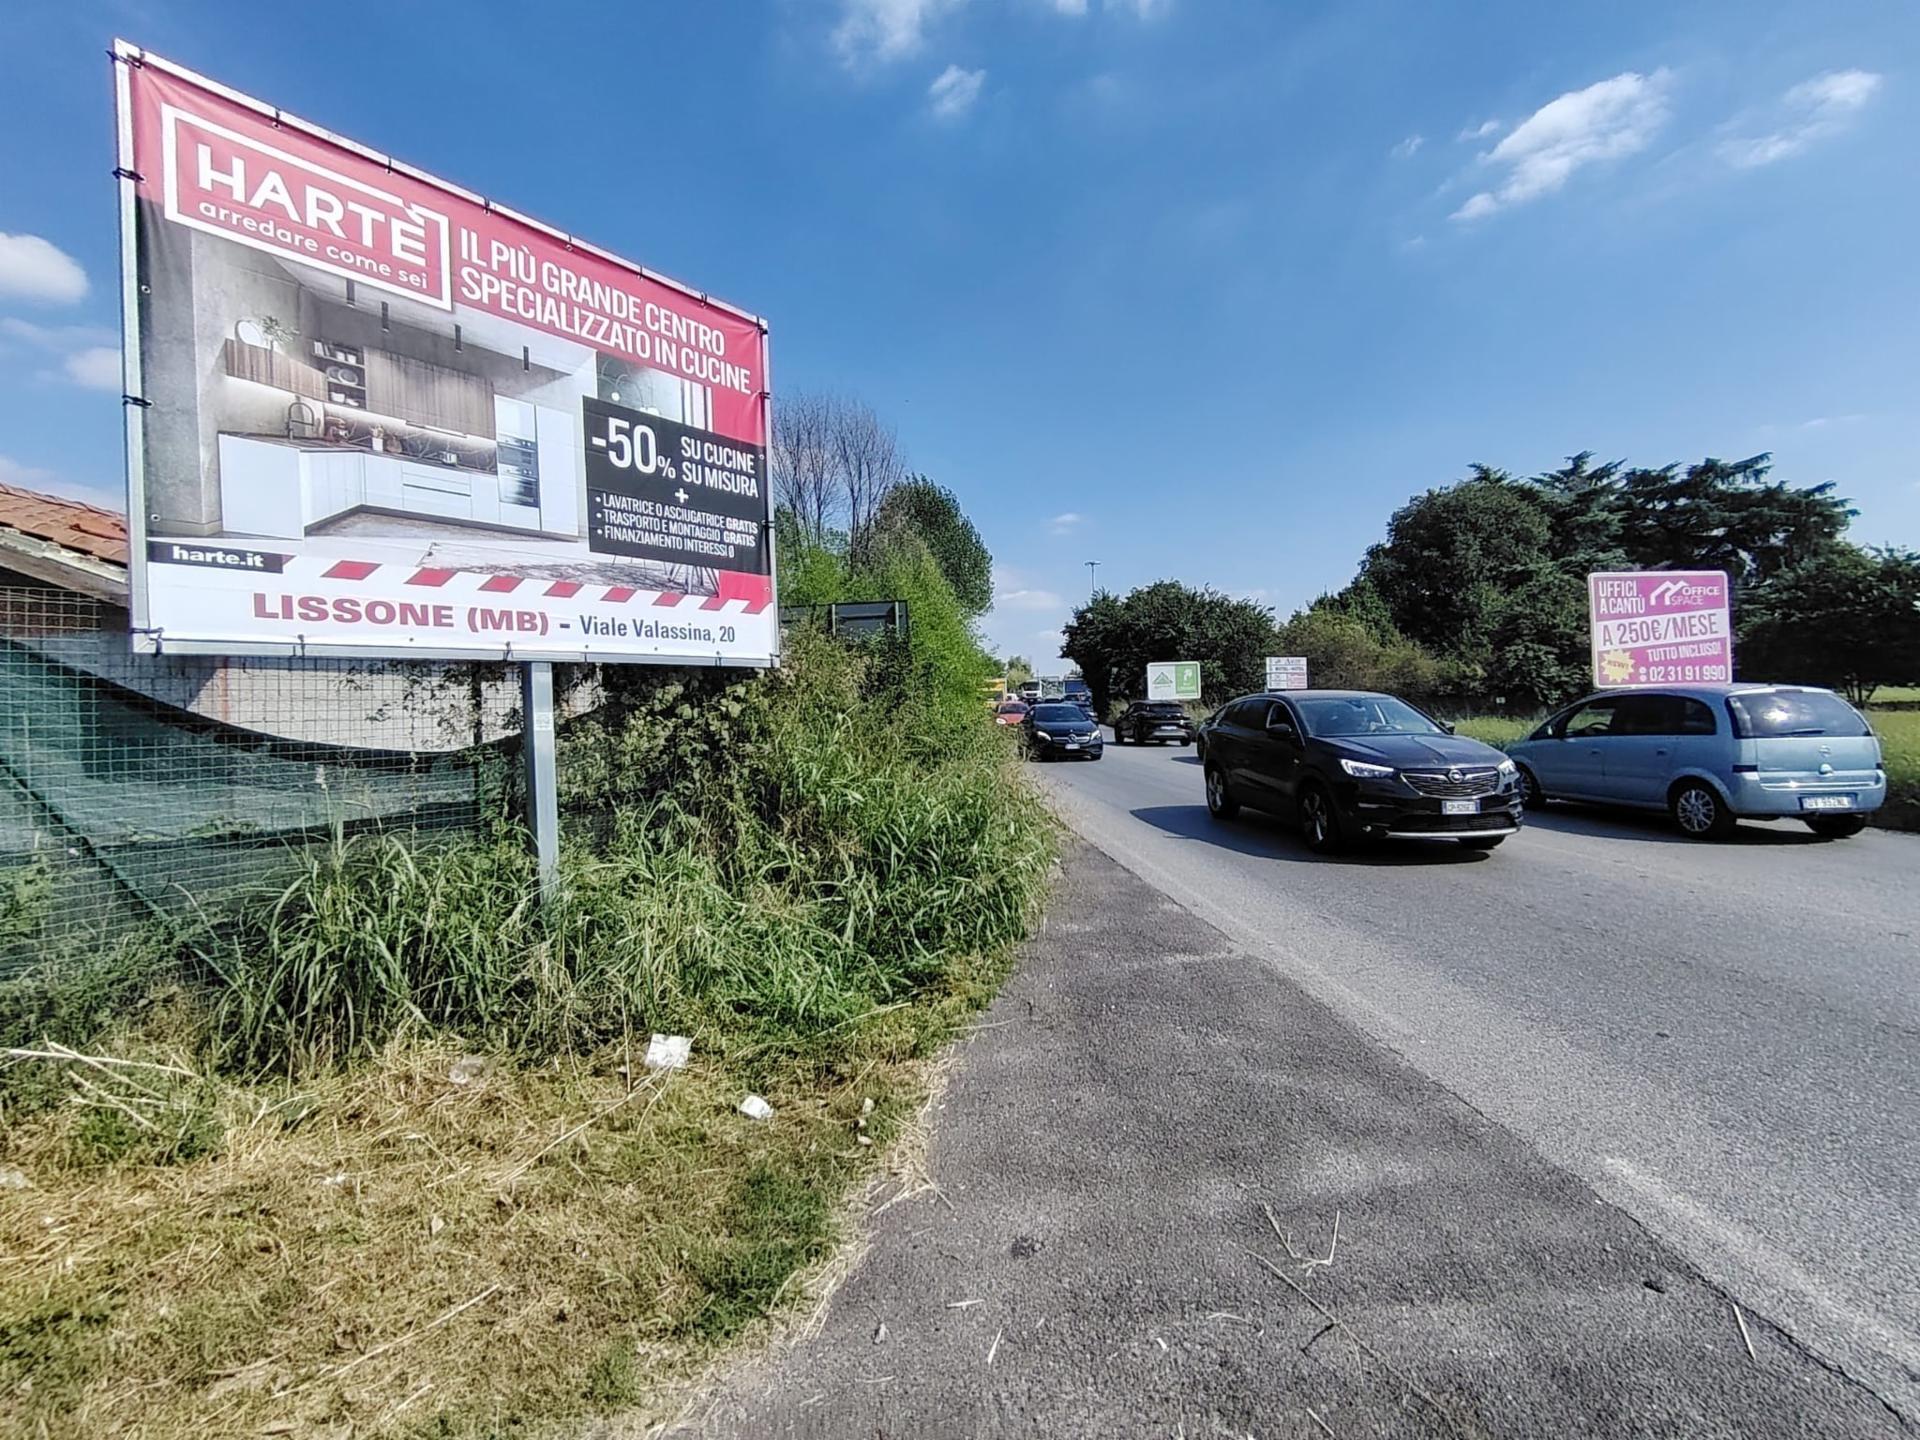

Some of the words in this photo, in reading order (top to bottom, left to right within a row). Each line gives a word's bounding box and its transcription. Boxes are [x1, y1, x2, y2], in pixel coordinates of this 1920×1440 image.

[197, 143, 426, 267] HARTÈ
[199, 201, 319, 252] arredare
[326, 245, 391, 276] come
[398, 271, 428, 288] sei
[460, 227, 486, 267] IL
[491, 239, 536, 285] PIÙ
[542, 261, 642, 325] GRANDE
[645, 302, 725, 356] CENTRO
[460, 266, 651, 359] SPECIALIZZATO
[655, 337, 677, 369] IN
[681, 347, 751, 395] CUCINE
[592, 416, 676, 479] -50%
[681, 436, 701, 460] SU
[704, 442, 755, 474] CUCINE
[682, 461, 702, 484] SU
[705, 468, 759, 498] MISURA
[603, 492, 654, 515] LAVATRICE
[664, 504, 725, 528] ASCIUGATRICE
[725, 517, 758, 534] GRATIS
[603, 509, 660, 531] TRASPORTO
[662, 519, 668, 532] E
[669, 521, 720, 540] MONTAGGIO
[723, 531, 756, 547] GRATIS
[172, 545, 264, 568] harte.it
[605, 526, 683, 550] FINANZIAMENTO
[684, 538, 728, 558] INTERESSI
[1598, 580, 1637, 597] UFFICI
[1600, 599, 1608, 614] A
[1671, 596, 1704, 606] SPACE
[1682, 586, 1720, 596] OFFICE
[253, 592, 454, 628] LISSONE
[467, 607, 549, 636] (MB)
[579, 614, 627, 637] Viale
[632, 618, 716, 644] Valassina,
[719, 626, 735, 643] 20
[1602, 624, 1613, 647] A
[1616, 613, 1719, 646] 250€/MESE
[1647, 648, 1677, 662] TUTTO
